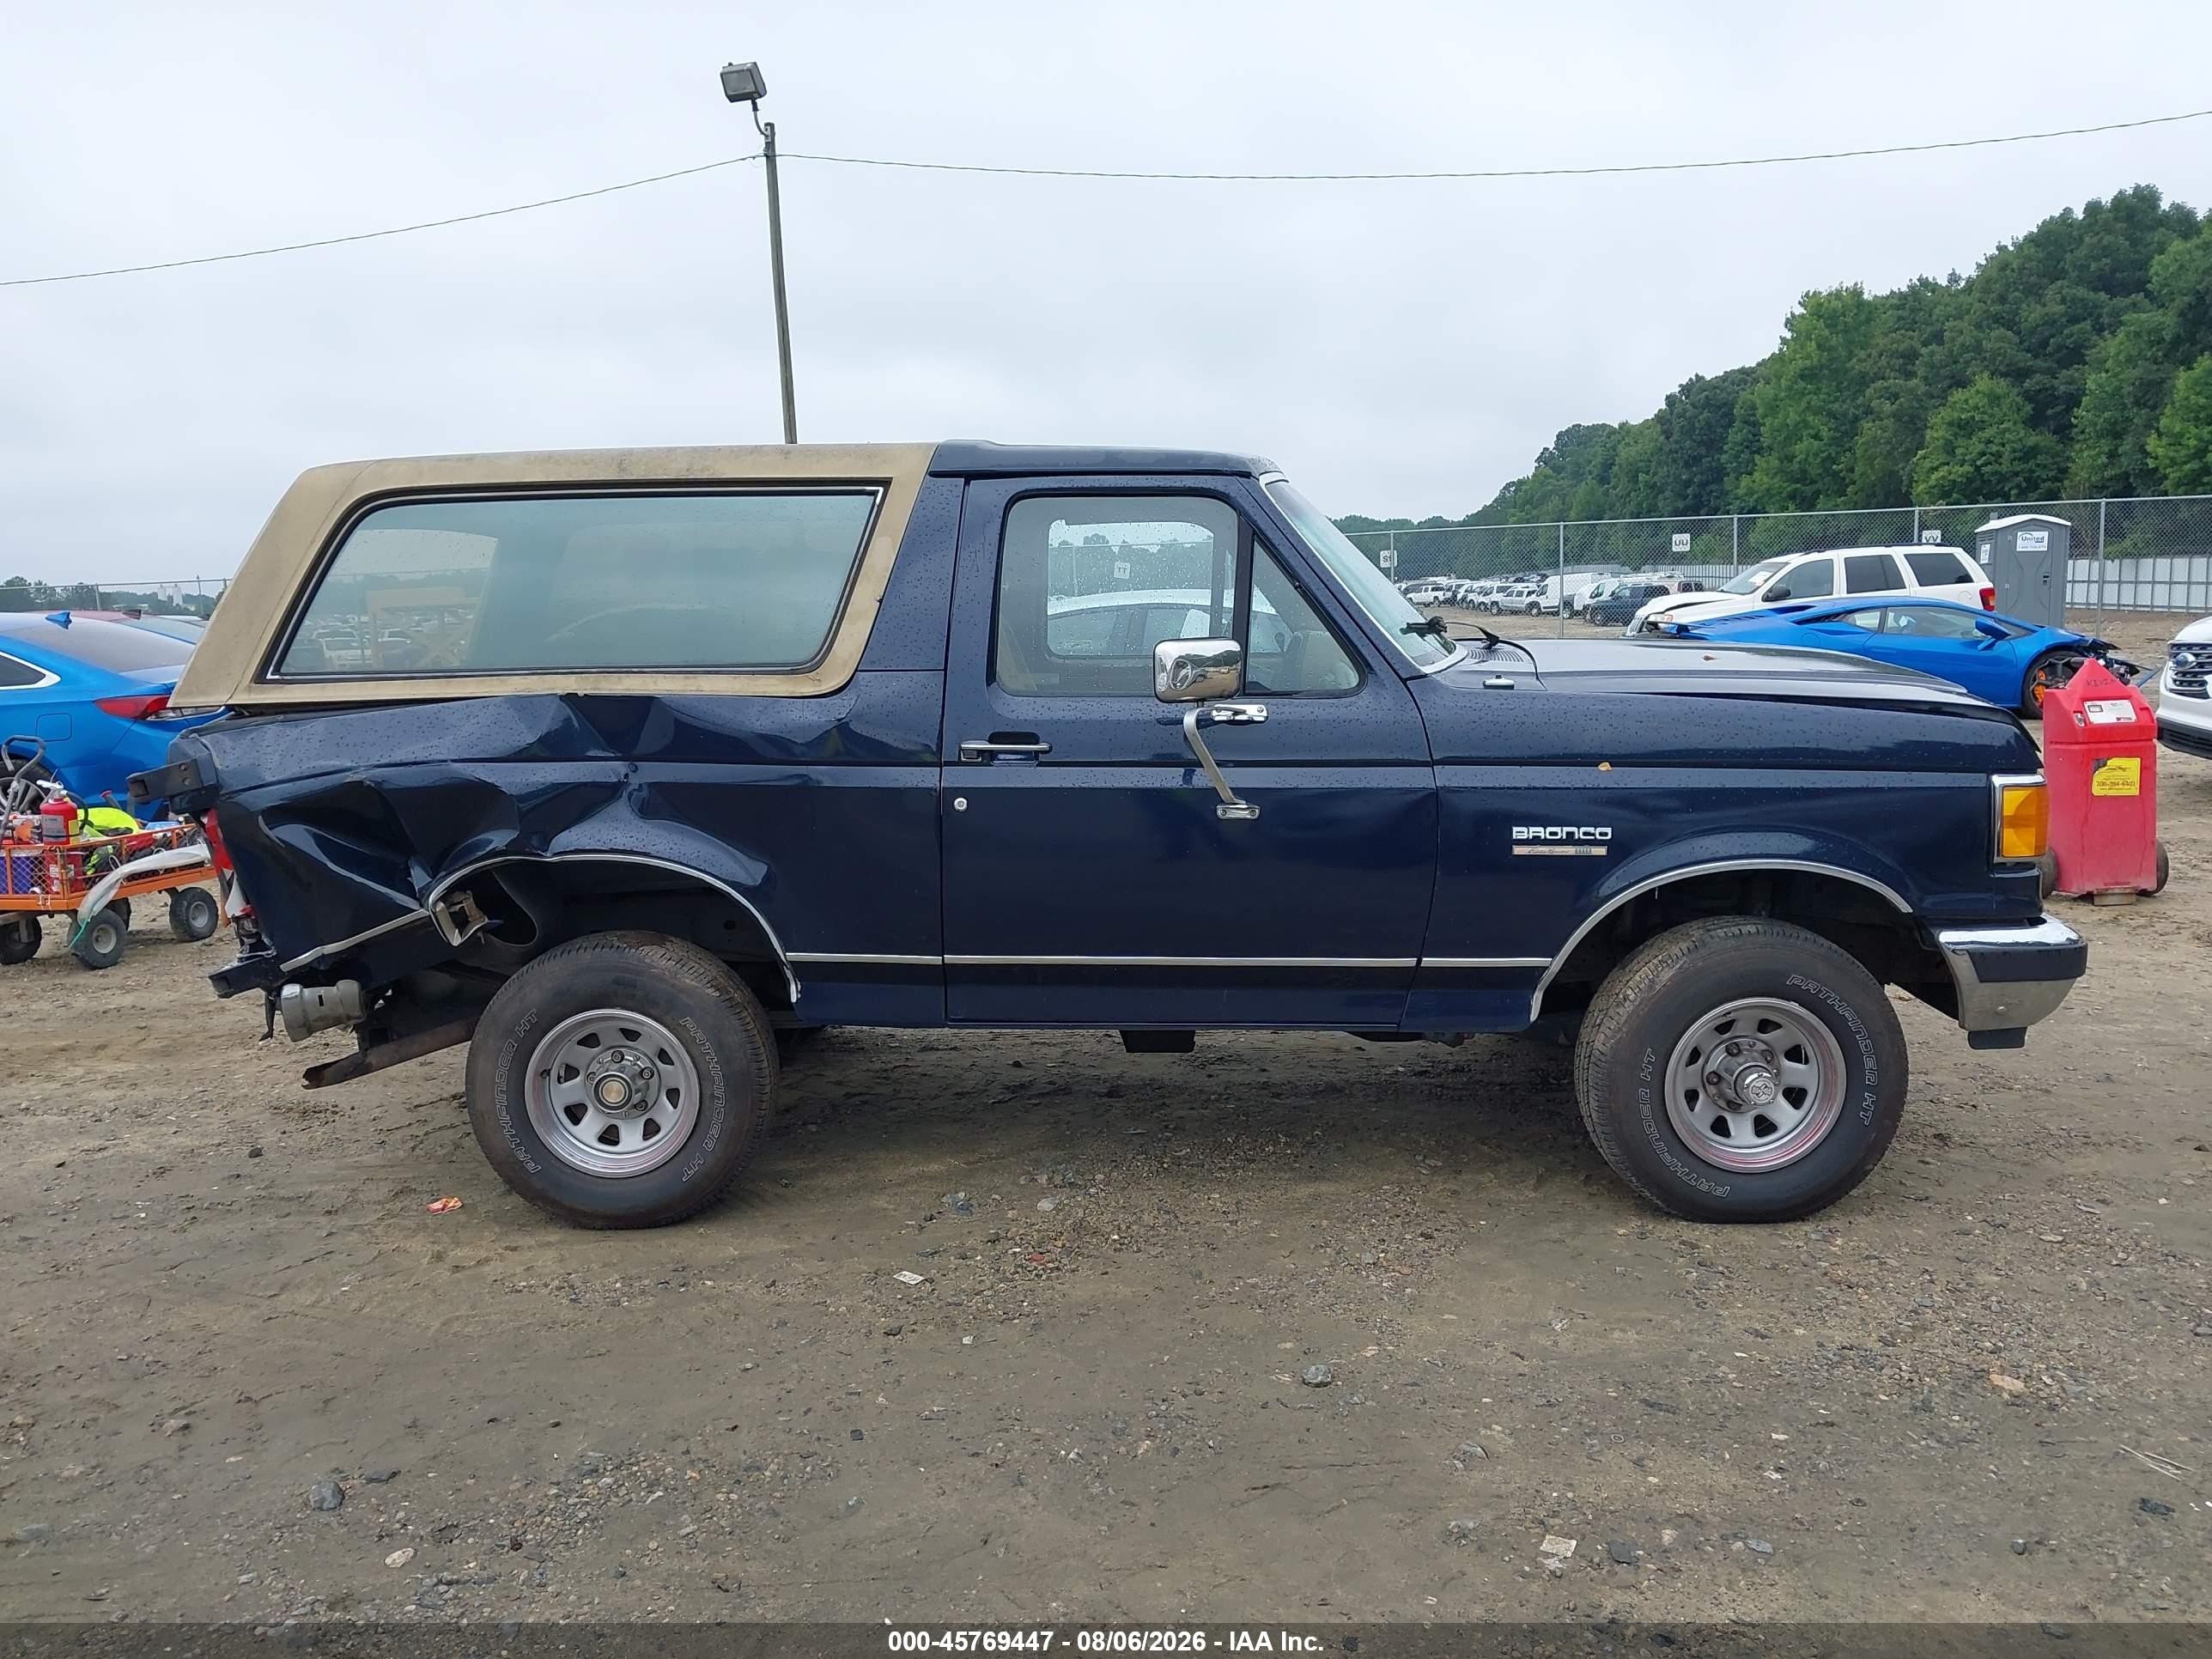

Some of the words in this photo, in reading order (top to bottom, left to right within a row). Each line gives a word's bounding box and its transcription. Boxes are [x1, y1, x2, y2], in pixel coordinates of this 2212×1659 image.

[1511, 826, 1612, 840] BRONCO
[517, 1009, 538, 1038] HT
[1787, 975, 1878, 1086] PATHFINDER
[1862, 1091, 1876, 1126] HT
[680, 1016, 727, 1154] PATHFINDER
[1641, 1048, 1656, 1082] HT
[495, 1036, 543, 1176] PATHFINDER
[682, 1153, 705, 1182] HT
[1638, 1089, 1732, 1198] PATHFINDER
